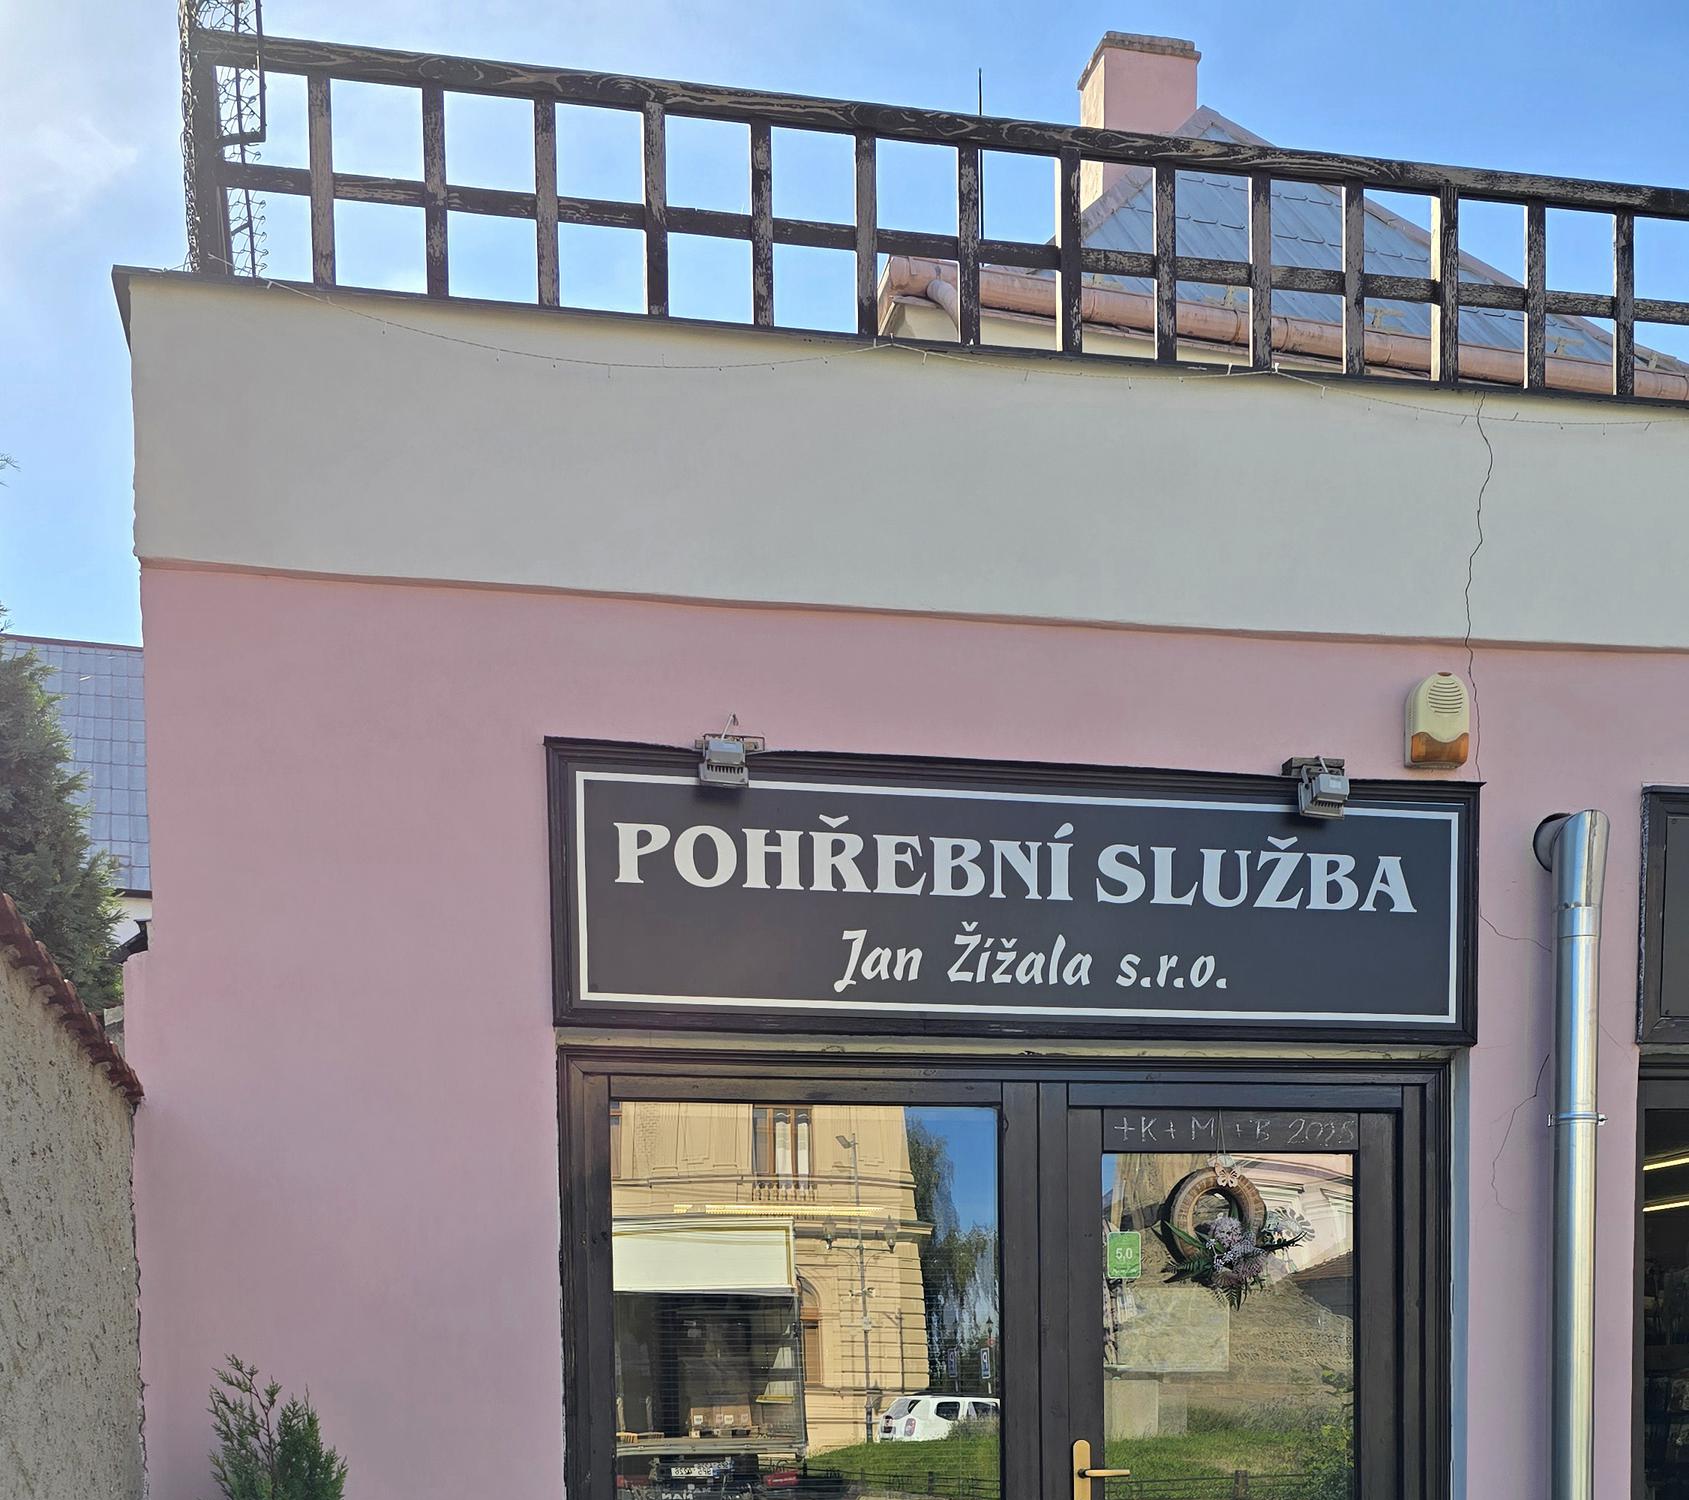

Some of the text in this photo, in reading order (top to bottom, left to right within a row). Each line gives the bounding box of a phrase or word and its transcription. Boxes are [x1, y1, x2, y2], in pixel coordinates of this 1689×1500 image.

[613, 814, 1418, 913] POHŘEBNÍ SLUŽBA
[833, 920, 1228, 993] Jan Žížala s.r.o.
